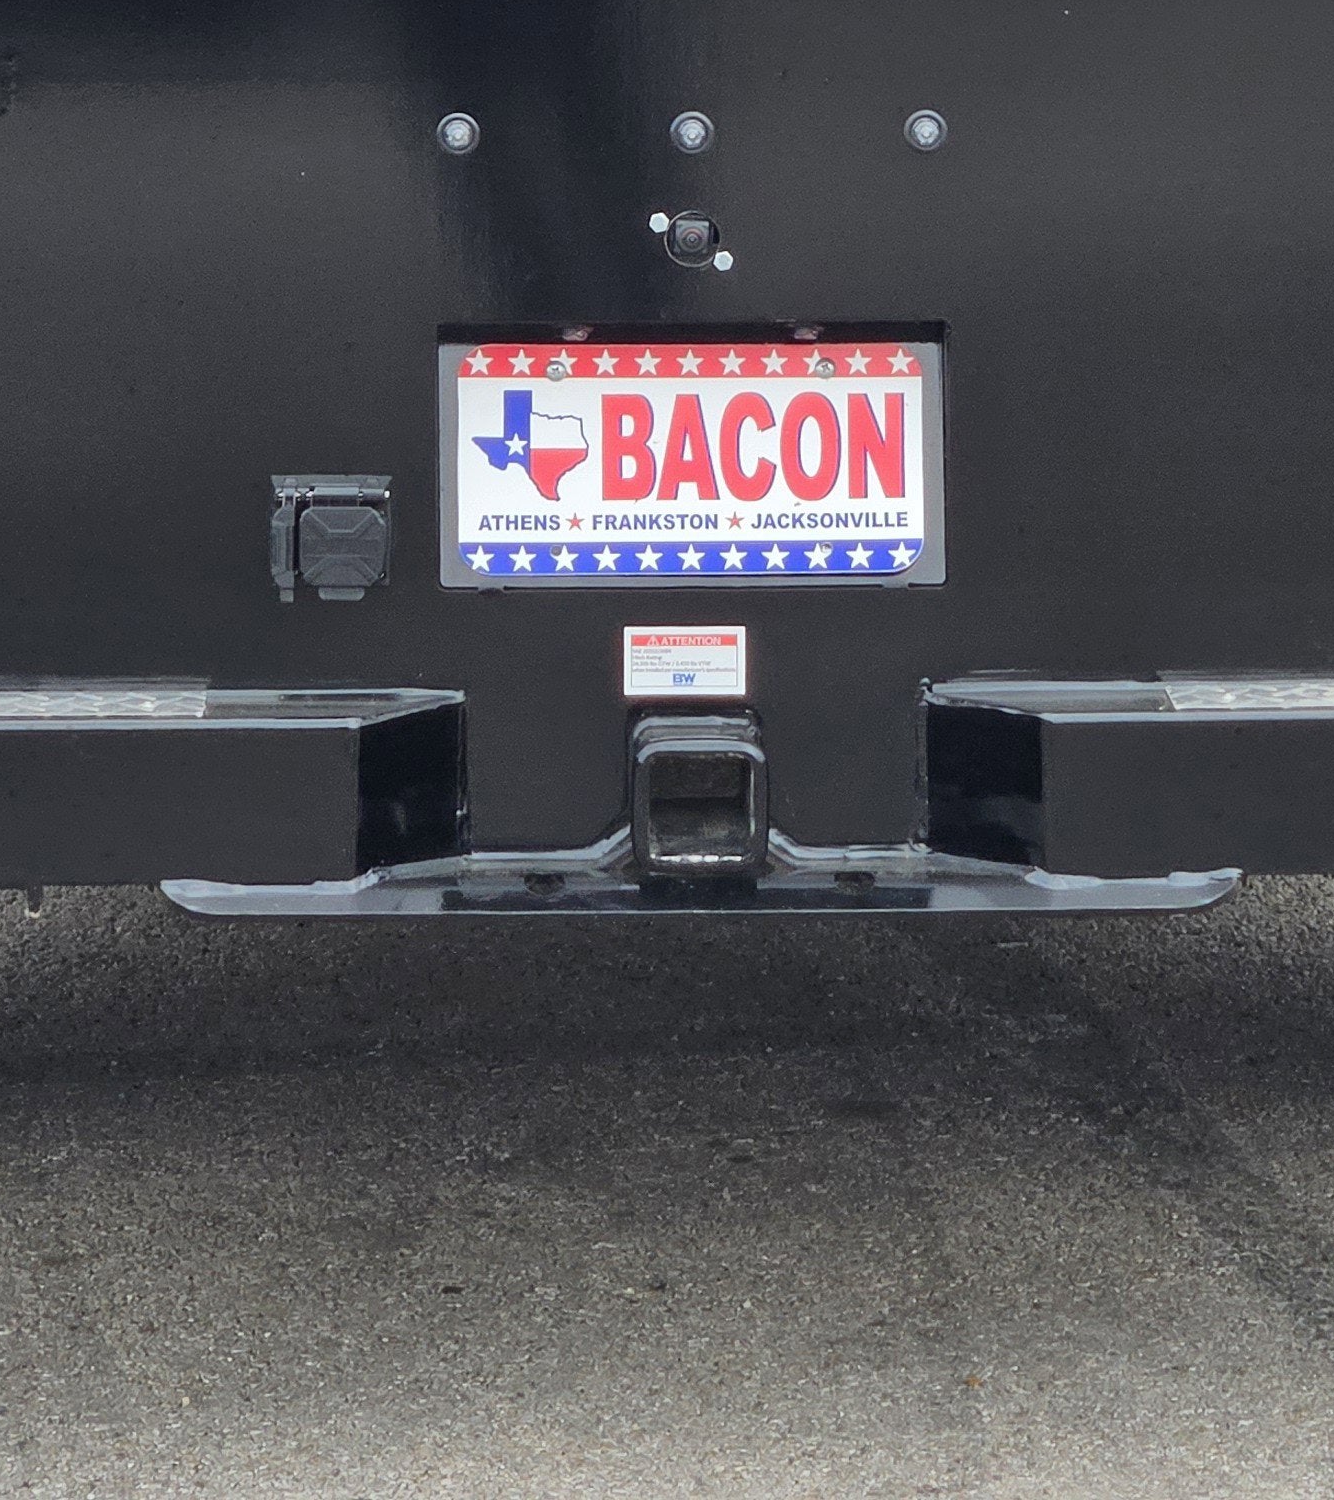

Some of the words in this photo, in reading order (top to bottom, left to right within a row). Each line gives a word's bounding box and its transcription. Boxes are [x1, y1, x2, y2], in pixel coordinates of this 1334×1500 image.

[601, 391, 906, 501] BACON
[478, 514, 561, 532] ATHENS
[591, 512, 719, 531] FRANKSTON
[750, 511, 909, 530] JACKSONVILLE
[661, 636, 721, 646] ATTENTION
